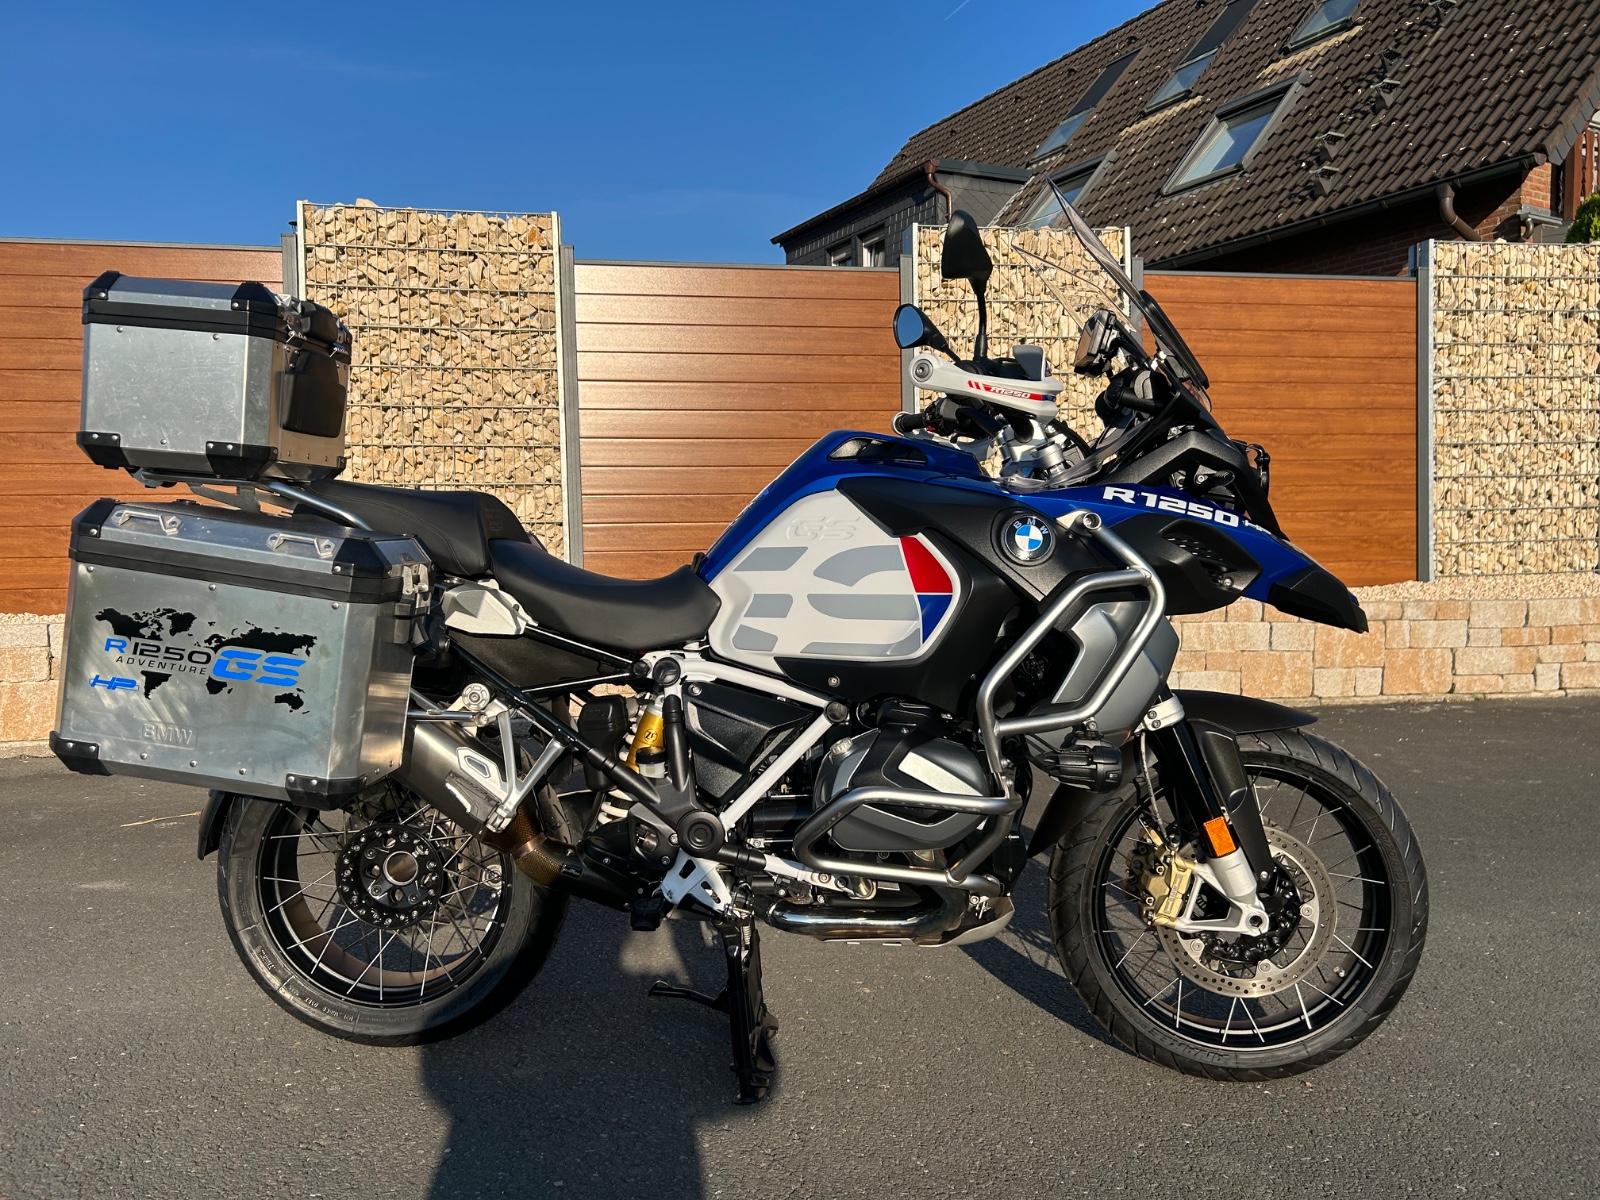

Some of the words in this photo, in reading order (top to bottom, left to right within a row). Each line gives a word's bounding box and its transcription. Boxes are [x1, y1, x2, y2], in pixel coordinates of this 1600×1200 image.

[1013, 518, 1048, 535] BMW
[116, 656, 207, 675] ADVENTURE
[212, 649, 306, 687] GS
[143, 723, 193, 745] BMW
